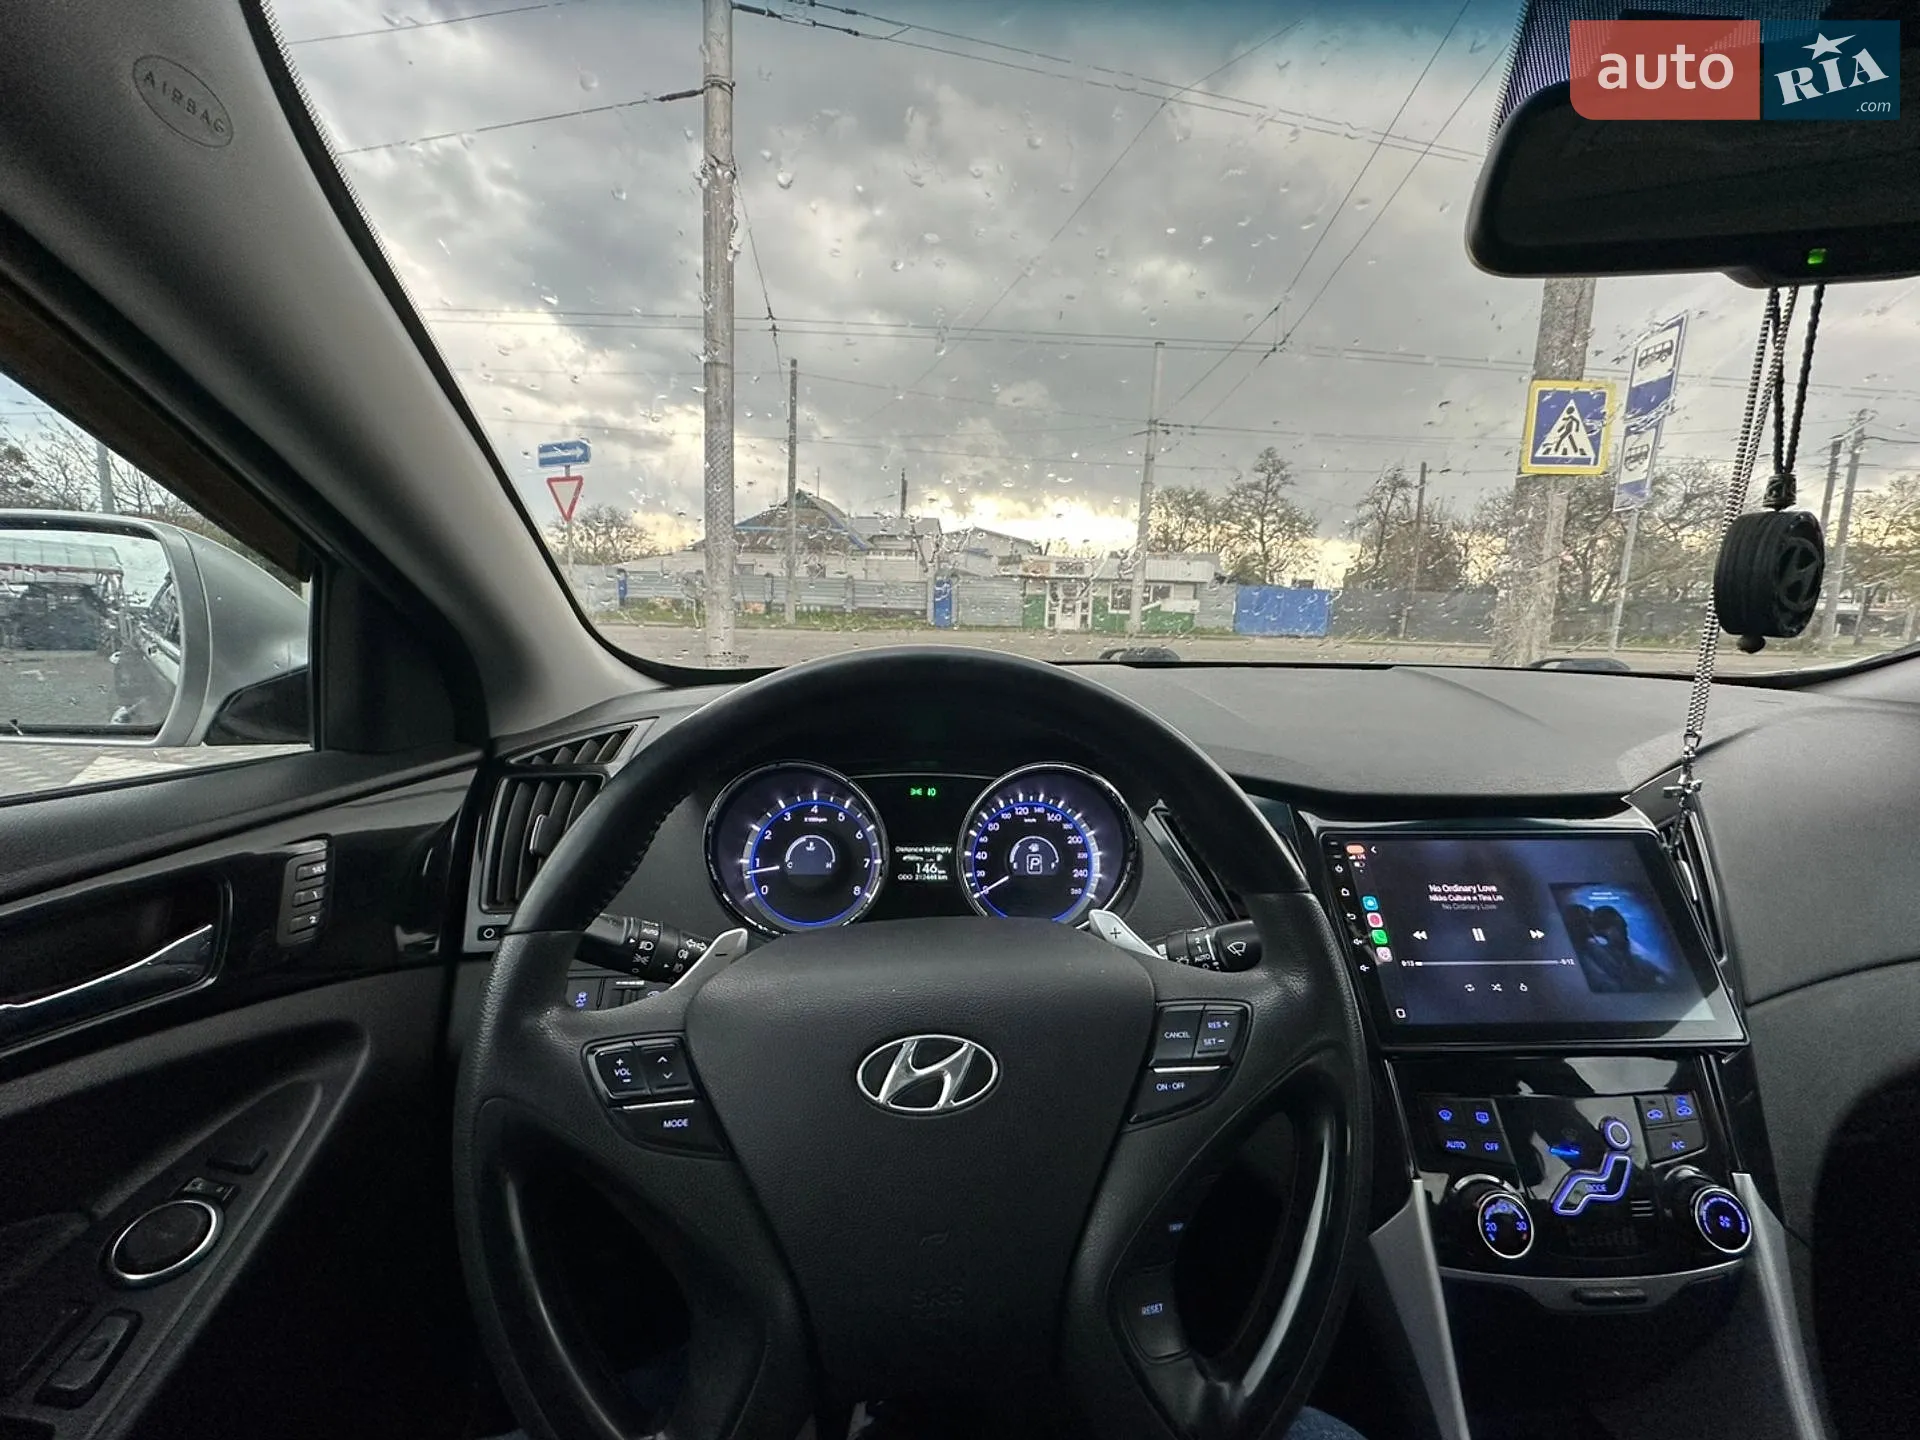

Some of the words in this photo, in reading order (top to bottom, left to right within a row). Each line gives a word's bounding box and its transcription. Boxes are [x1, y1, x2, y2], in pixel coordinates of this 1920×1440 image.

[143, 71, 225, 134] AIRBAG
[811, 805, 818, 814] 4
[1015, 807, 1029, 815] 120
[783, 812, 791, 821] 3
[838, 812, 845, 821] 5
[764, 830, 772, 839] 2
[855, 830, 863, 839] 6
[1067, 836, 1083, 844] 200
[975, 852, 988, 860] 40
[863, 859, 870, 868] 7
[1030, 857, 1040, 870] P
[916, 863, 938, 874] 146
[1072, 869, 1088, 877] 240
[761, 885, 768, 895] 0
[853, 886, 861, 895] 8
[1428, 884, 1442, 892] No
[1442, 884, 1476, 894] Ordinary
[1477, 884, 1498, 892] Love
[1164, 1031, 1190, 1039] CANCEL
[614, 1068, 632, 1076] VOL
[663, 1118, 688, 1128] MODE
[1485, 1222, 1498, 1232] 20
[1516, 1220, 1528, 1231] 30
[1141, 1303, 1163, 1315] RESET
